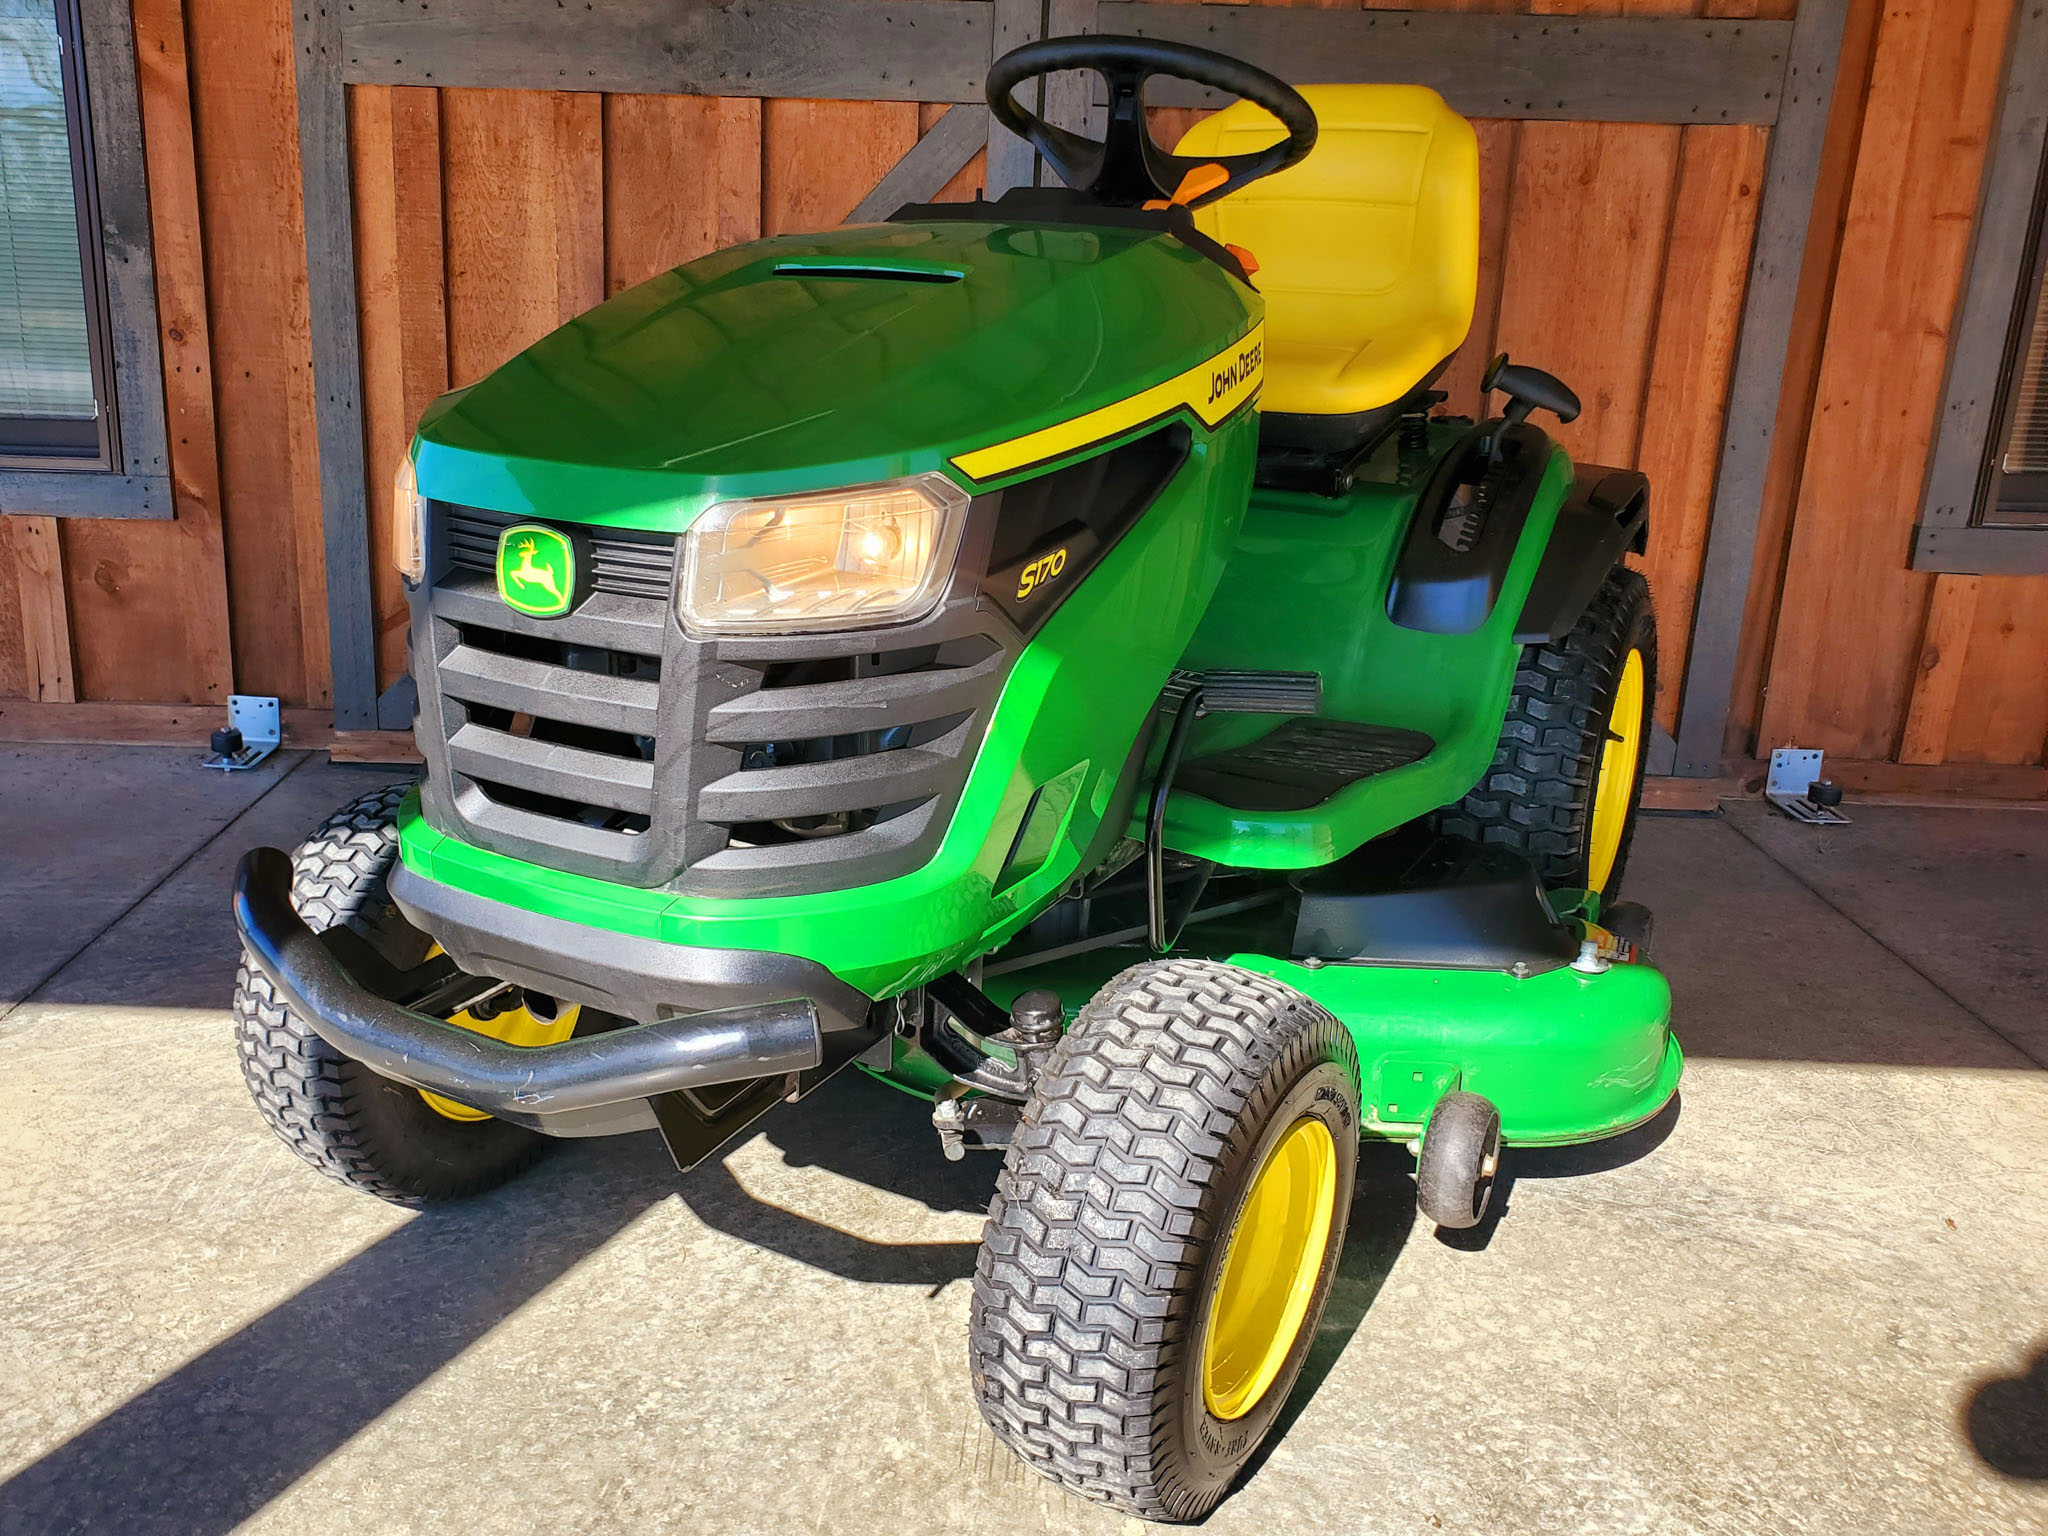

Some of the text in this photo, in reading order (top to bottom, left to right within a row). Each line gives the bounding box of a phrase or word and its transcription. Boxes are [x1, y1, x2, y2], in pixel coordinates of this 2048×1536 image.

[1208, 341, 1262, 405] JOHN DEERE
[1017, 548, 1067, 599] S170
